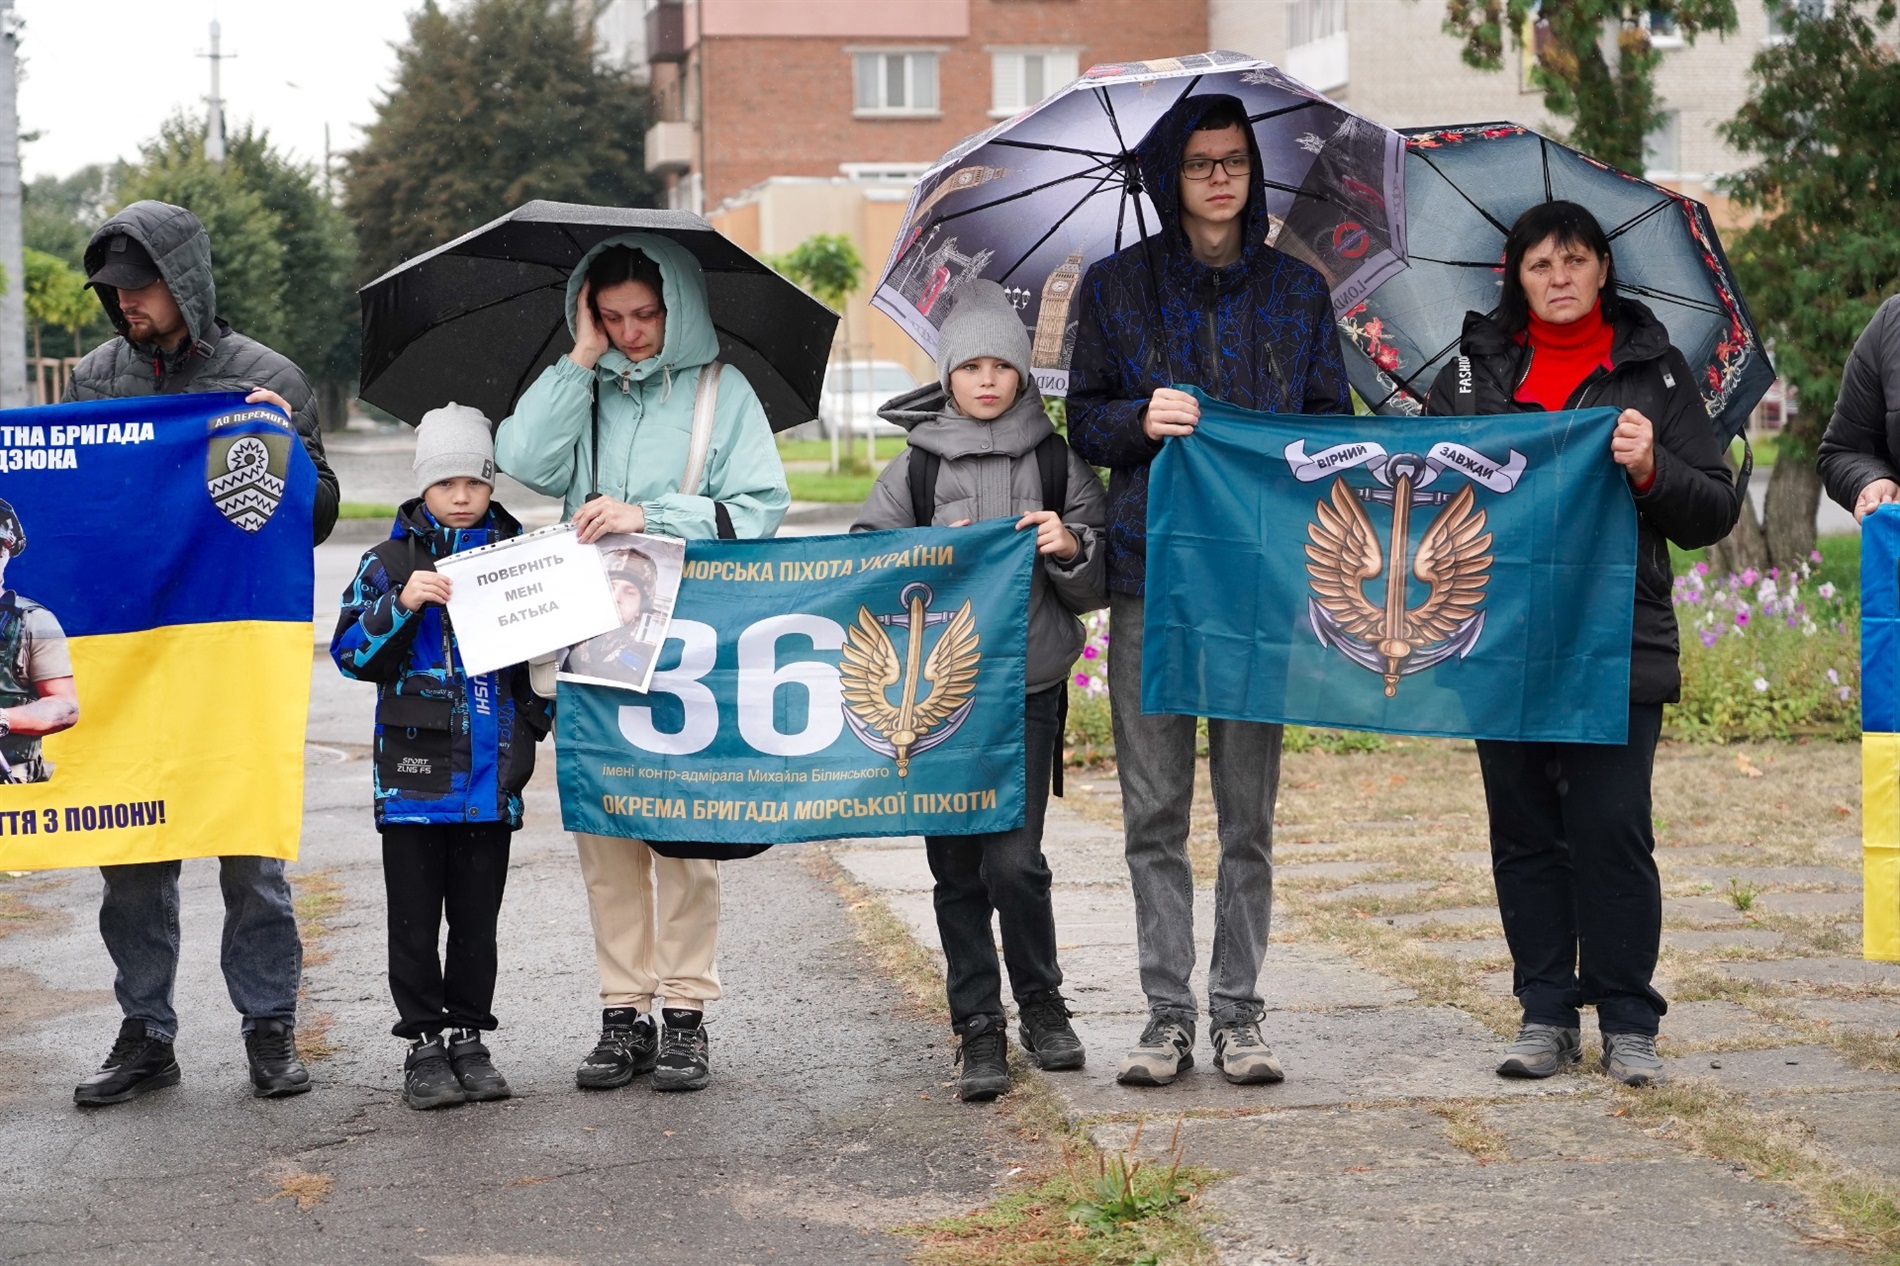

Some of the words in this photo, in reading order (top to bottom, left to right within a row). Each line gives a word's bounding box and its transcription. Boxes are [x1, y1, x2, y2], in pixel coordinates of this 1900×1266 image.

[0, 425, 46, 447] ТНА
[50, 422, 155, 446] БРИГАДА
[214, 415, 230, 428] ДО
[234, 410, 289, 428] ПЕРЕМОГИ
[1316, 445, 1368, 469] ВІРНИЙ
[1439, 446, 1494, 480] ЗАВЖДИ
[477, 554, 564, 587] ПОВЕРНІТЬ
[682, 560, 774, 582] МОРСЬКА
[779, 559, 853, 582] ПІХОТА
[857, 545, 954, 574] УКРАЇНИ
[504, 582, 544, 602] МЕНІ
[498, 600, 560, 627] БАТЬКА
[617, 613, 847, 757] 36
[602, 763, 635, 777] імені
[638, 765, 744, 784] контр-адмірала
[747, 767, 808, 783] Михайла
[811, 766, 890, 782] Білинського
[65, 800, 166, 832] ПОЛОНУ!
[602, 794, 686, 819] ОКРЕМА
[692, 800, 789, 823] БРИГАДА
[794, 791, 907, 821] МОРСЬКОЇ
[913, 789, 997, 815] ПІХОТИ
